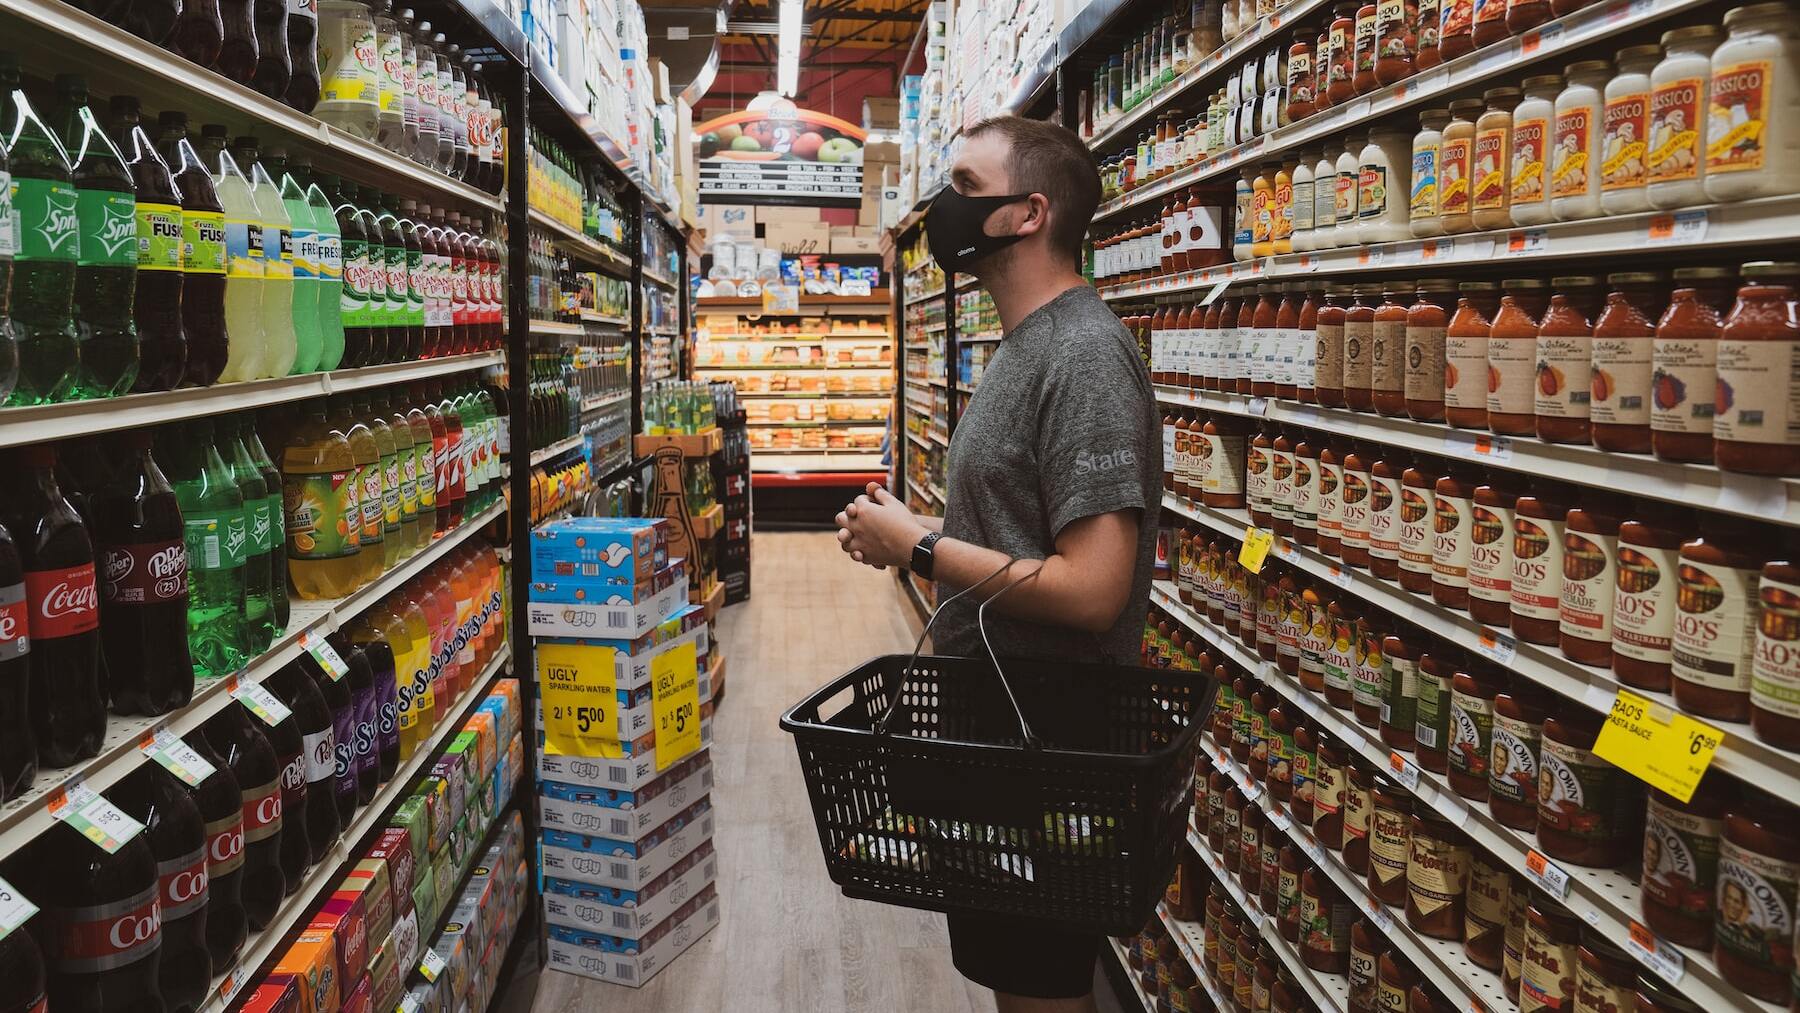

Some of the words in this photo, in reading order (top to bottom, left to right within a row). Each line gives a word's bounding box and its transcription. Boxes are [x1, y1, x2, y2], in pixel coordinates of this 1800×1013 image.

[773, 127, 791, 153] 2
[332, 474, 345, 482] NEW
[163, 581, 173, 592] 23
[548, 668, 578, 682] UGLY
[657, 673, 675, 692] UGLY
[550, 683, 584, 693] SPARKLING
[586, 686, 611, 694] WATER
[1612, 698, 1644, 721] RAO'S
[1460, 715, 1476, 744] OWN
[1606, 714, 1630, 730] PASTA
[1629, 723, 1654, 741] SAUCE
[1514, 747, 1532, 774] OWN
[1558, 770, 1578, 801] OWN
[1375, 830, 1406, 847] Organic
[1666, 836, 1690, 876] OWN
[1755, 888, 1786, 928] OWN
